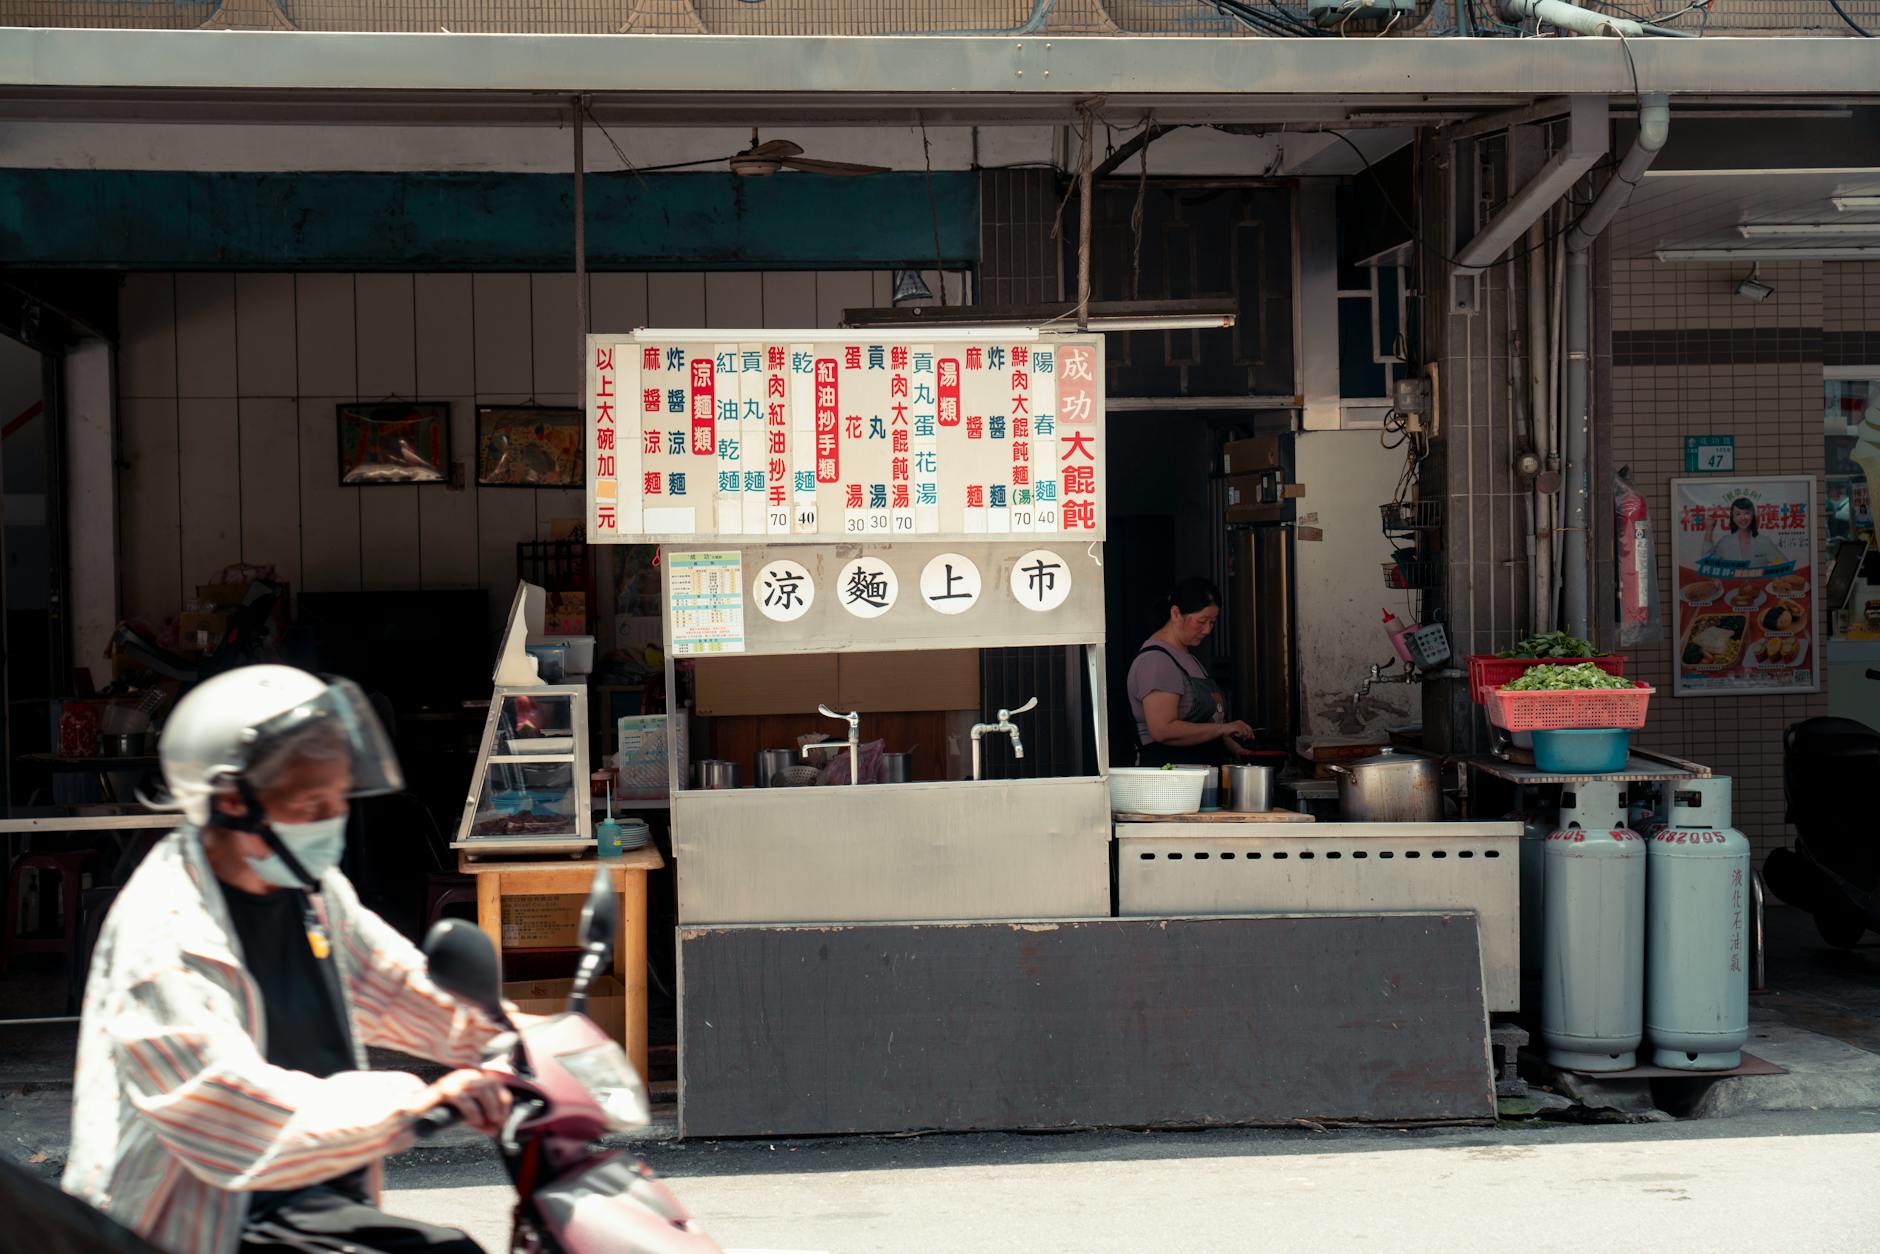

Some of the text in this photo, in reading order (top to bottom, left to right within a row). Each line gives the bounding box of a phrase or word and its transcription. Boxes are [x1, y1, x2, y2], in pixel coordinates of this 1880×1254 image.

[643, 347, 662, 496] 麻醬涼麵
[667, 347, 687, 497] 炸醬涼麵
[693, 361, 713, 452] 涼麵類
[716, 352, 741, 492] 紅油乾麵
[741, 351, 766, 492] 貢丸麵
[768, 347, 787, 526] 鮮肉紅油抄手 70
[818, 361, 837, 480] 紅油抄手類
[845, 346, 865, 532] 蛋花湯 30
[868, 345, 888, 528] 貢丸湯 30
[891, 346, 913, 530] 鮮肉大餛飩湯 70
[913, 352, 937, 505] 貢丸蛋花湯
[940, 361, 958, 422] 湯類
[966, 347, 983, 508] 麻醬麵
[988, 346, 1006, 508] 炸醬麵
[1011, 346, 1029, 486] 鮮肉大餛飩麵
[1033, 352, 1057, 524] 陽春麵 40
[1061, 349, 1096, 530] 成功 大餛飩
[1708, 455, 1724, 468] 47
[764, 559, 1061, 610] 涼麵上市
[798, 511, 815, 524] 40
[1014, 512, 1031, 525] 70
